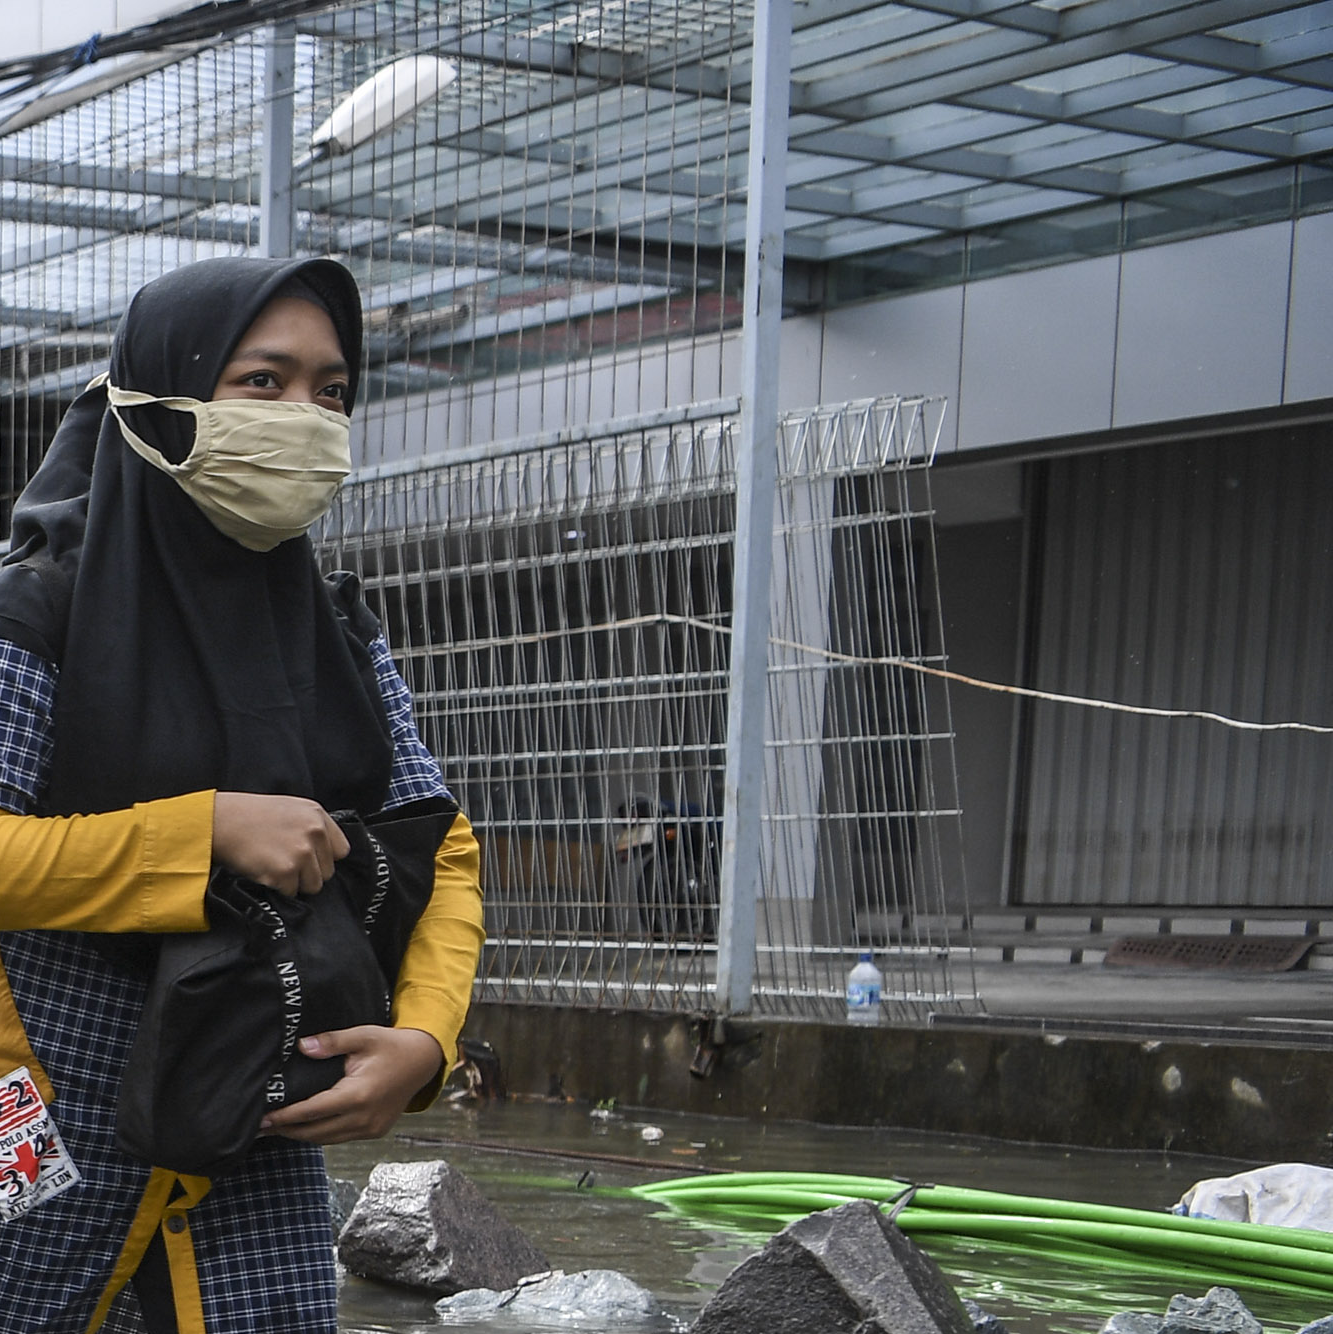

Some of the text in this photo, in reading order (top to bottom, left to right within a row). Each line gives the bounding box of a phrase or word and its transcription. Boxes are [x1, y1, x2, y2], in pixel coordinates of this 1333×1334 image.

[277, 961, 302, 1006] NEW
[266, 1012, 301, 1103] PARISE
[8, 1080, 33, 1109] 2
[3, 1169, 25, 1198] 3
[51, 1169, 74, 1188] LDN
[8, 1200, 29, 1217] NYC
